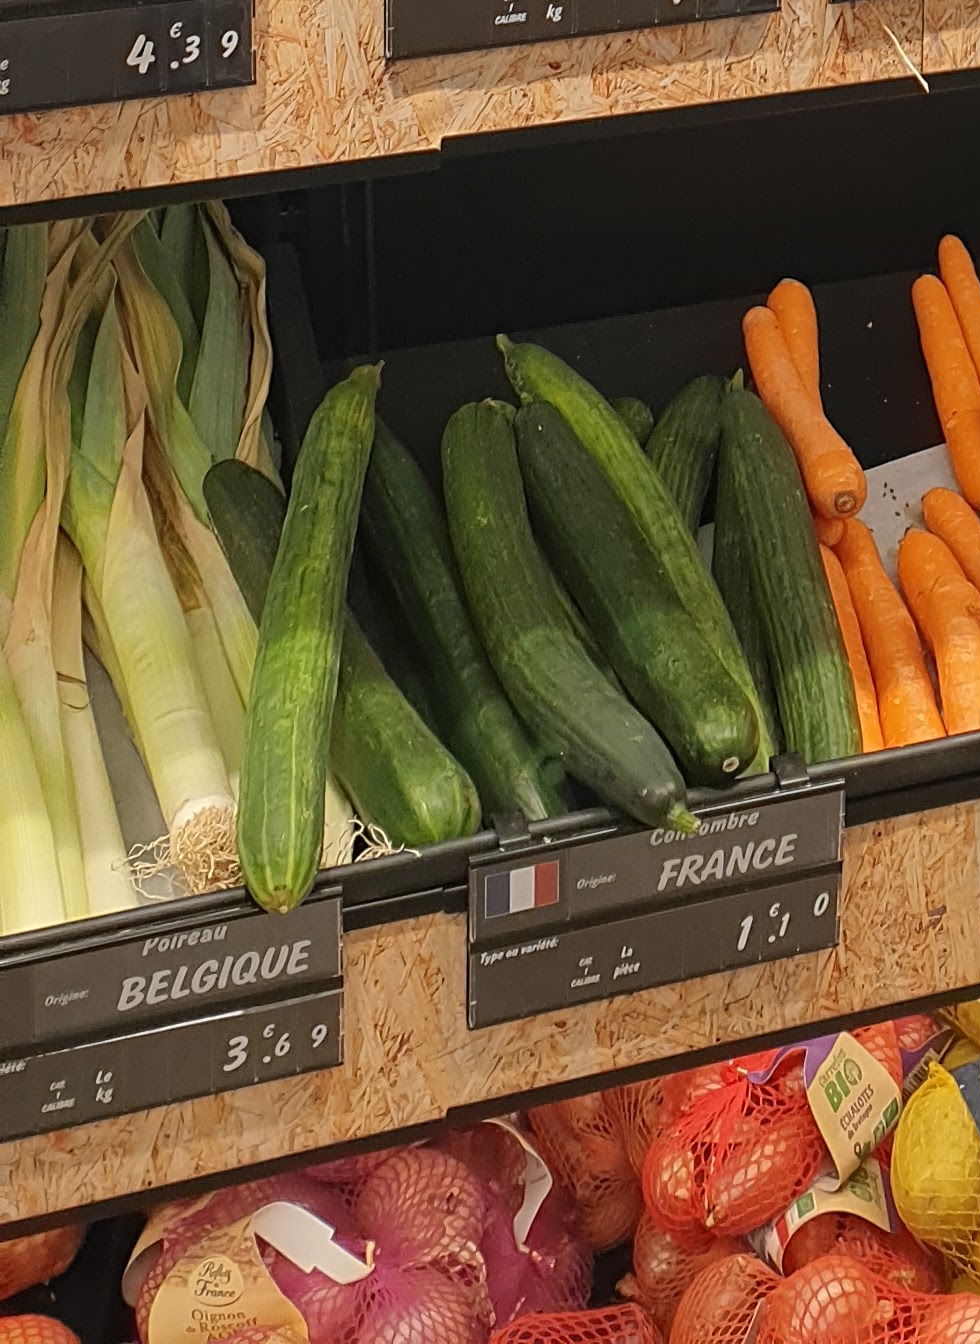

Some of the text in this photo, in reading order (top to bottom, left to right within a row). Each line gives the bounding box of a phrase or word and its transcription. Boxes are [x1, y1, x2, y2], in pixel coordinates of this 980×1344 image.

[546, 3, 562, 22] kg
[657, 834, 798, 891] FRANCE
[117, 940, 312, 1012] BELGIQUE
[825, 1059, 862, 1113] BIO
[194, 1279, 235, 1297] France
[191, 1309, 245, 1322] Oignon
